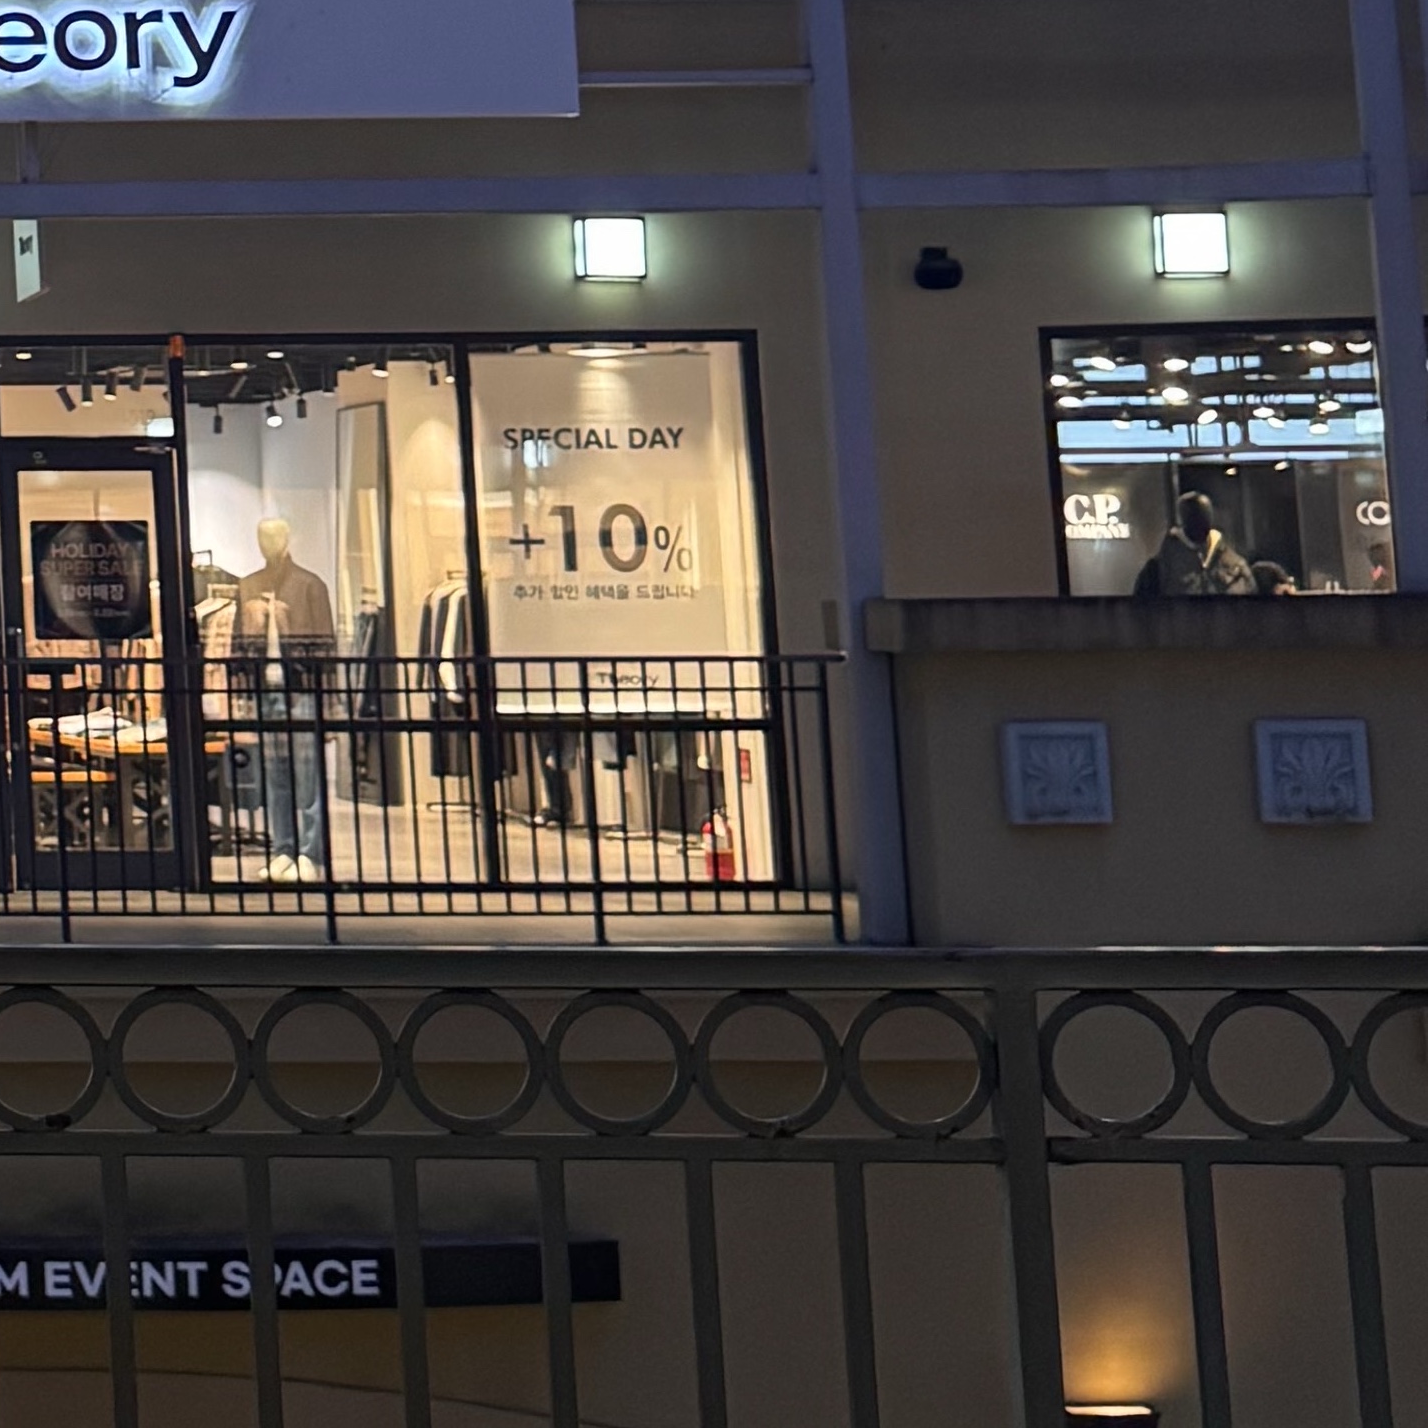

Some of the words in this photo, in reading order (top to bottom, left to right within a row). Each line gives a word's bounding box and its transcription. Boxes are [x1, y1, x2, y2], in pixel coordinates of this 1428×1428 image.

[503, 427, 618, 450] SPECIAL
[628, 427, 684, 449] DAY
[1063, 493, 1121, 525] C.P.
[509, 503, 693, 573] +10%
[51, 542, 129, 558] HOLIDAY
[40, 559, 94, 576] SUPER
[61, 583, 124, 602] 참여매장
[513, 584, 543, 600] 추가
[550, 584, 579, 600] 할인
[636, 584, 697, 599] 드립니다
[595, 671, 660, 687] Teoy
[221, 1258, 381, 1298] SACE
